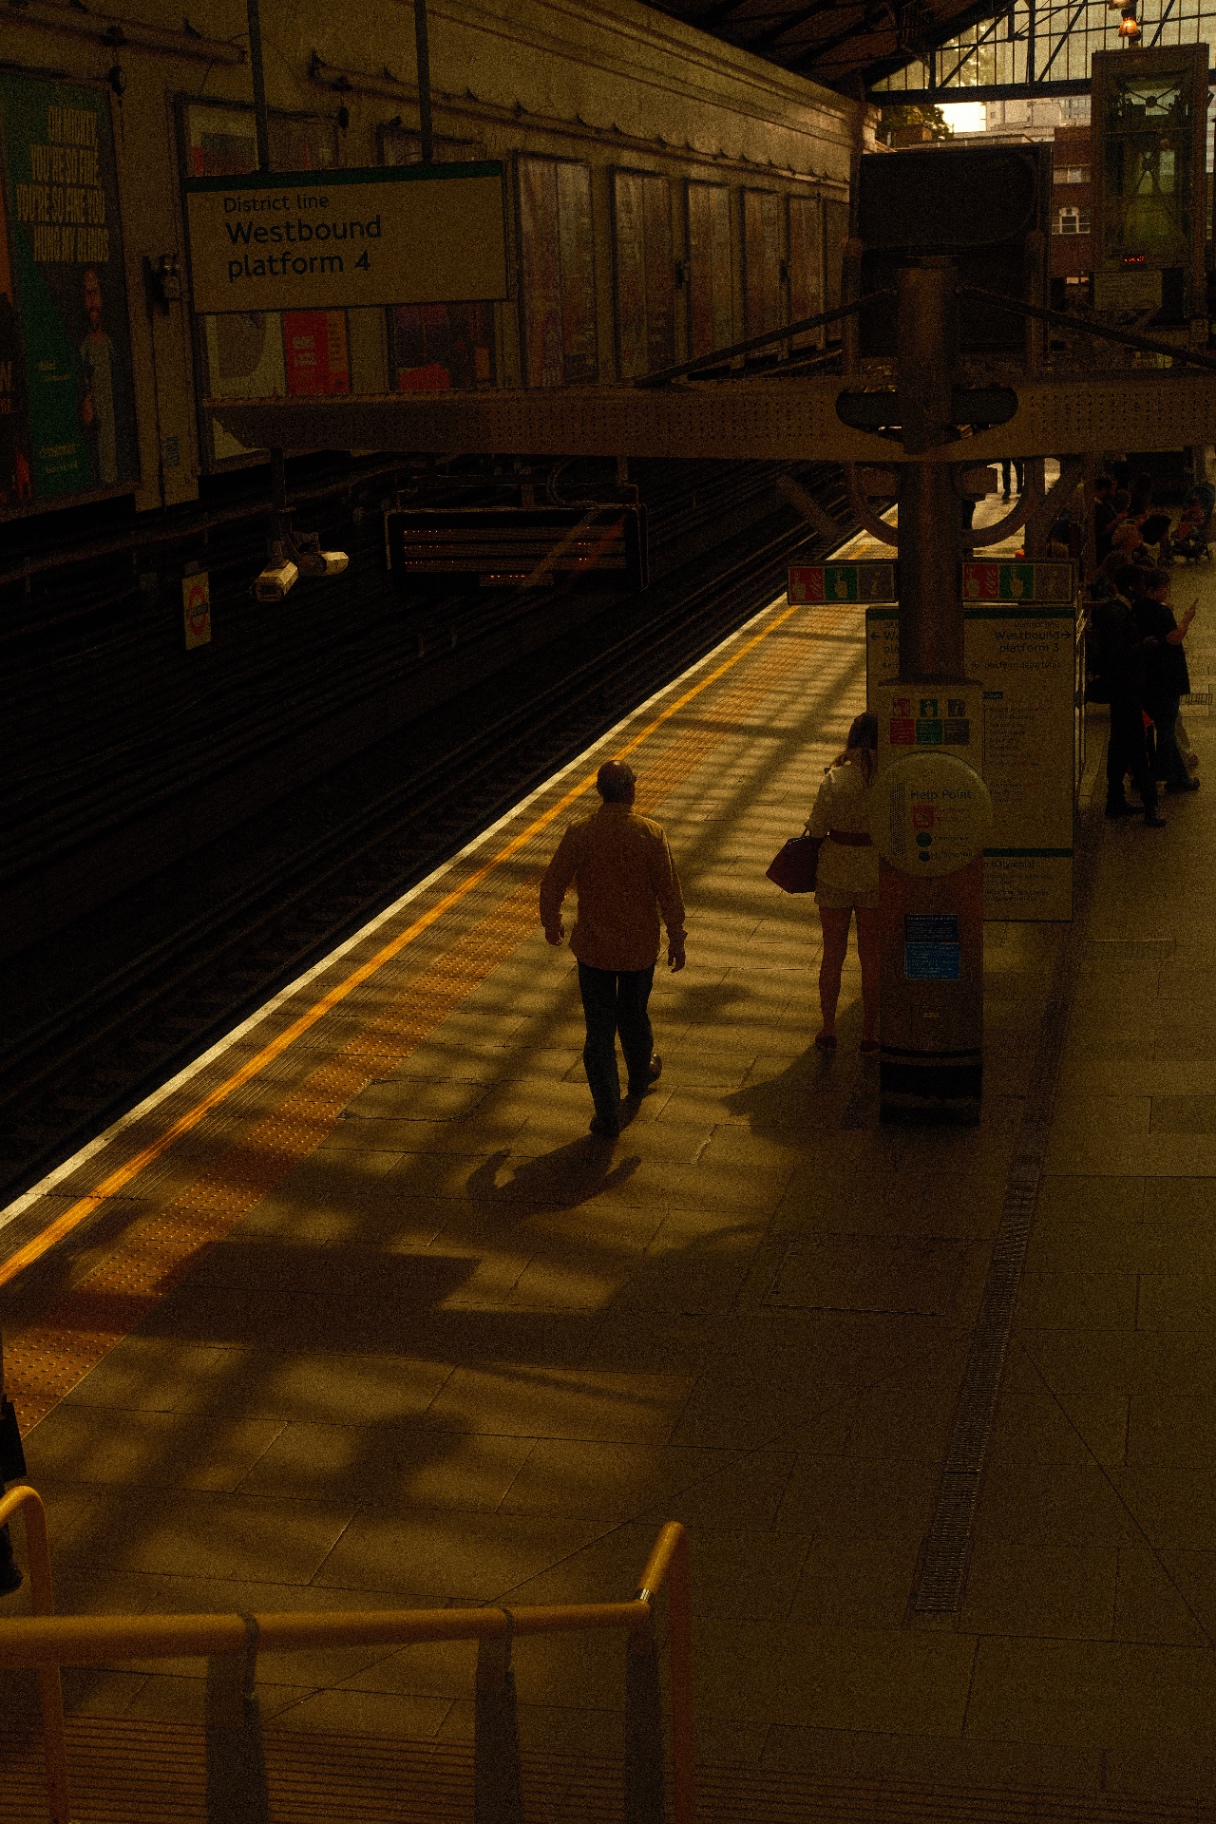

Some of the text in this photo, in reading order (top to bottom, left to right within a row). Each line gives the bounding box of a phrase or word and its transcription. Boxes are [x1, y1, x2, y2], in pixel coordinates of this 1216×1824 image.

[48, 105, 98, 150] OH MICKEY,
[30, 143, 102, 189] YOU'RE SO FINE,
[16, 183, 105, 225] YOU'RE SO FINE YOU
[223, 194, 329, 213] District line
[33, 225, 109, 263] HUNG MY BLINDS
[225, 215, 381, 245] Westbound
[228, 250, 370, 283] platform 4
[994, 630, 1060, 640] Westbound
[999, 642, 1060, 654] platform 3
[910, 788, 972, 803] Help Point
